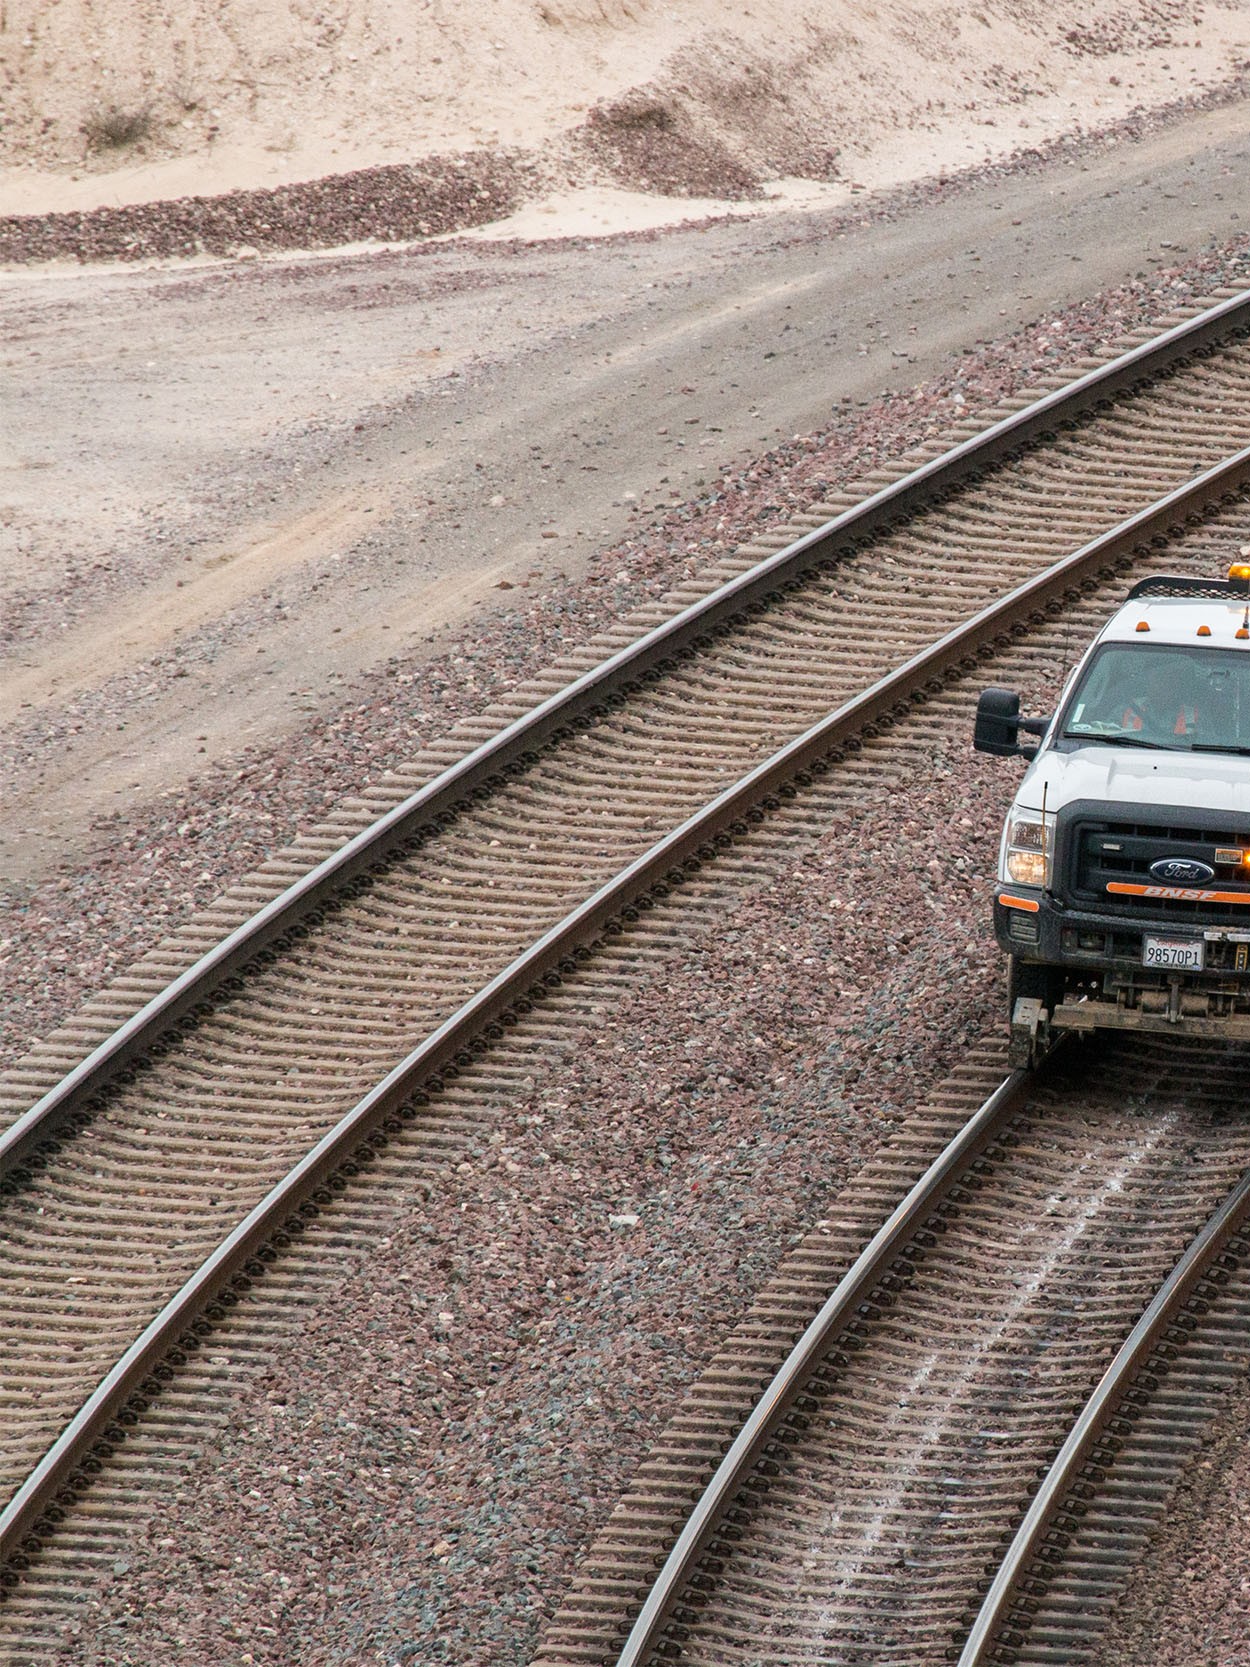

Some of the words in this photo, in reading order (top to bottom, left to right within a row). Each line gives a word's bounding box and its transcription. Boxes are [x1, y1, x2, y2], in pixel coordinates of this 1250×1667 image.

[1164, 862, 1199, 879] Ford
[1143, 887, 1217, 900] BNSF
[1147, 947, 1199, 966] 98570P1
